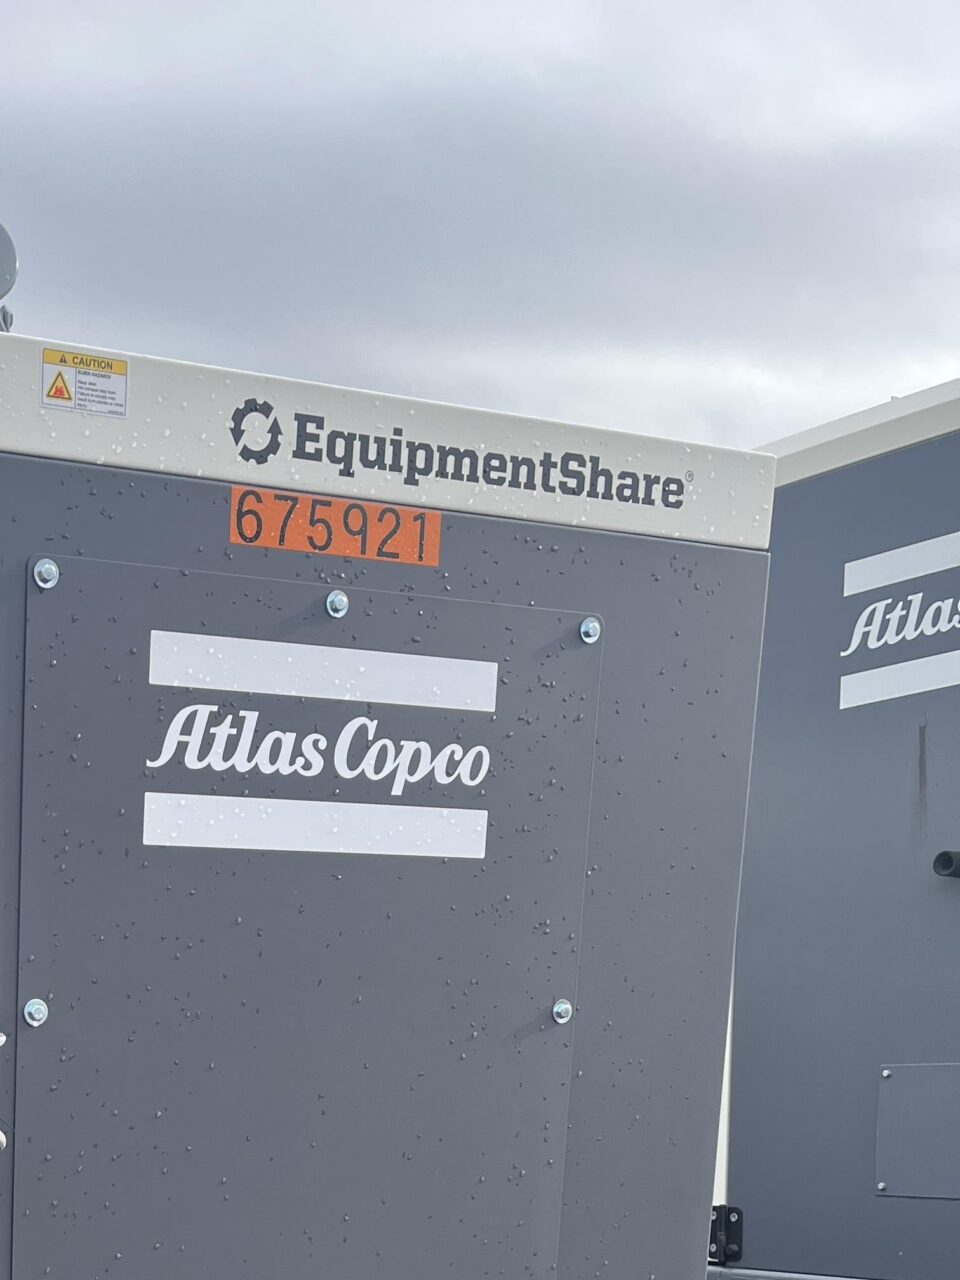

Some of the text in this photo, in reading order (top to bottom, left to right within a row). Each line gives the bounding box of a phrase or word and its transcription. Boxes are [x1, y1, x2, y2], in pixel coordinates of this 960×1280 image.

[72, 356, 113, 371] CAUTION
[292, 412, 685, 510] EquipmentShare
[236, 489, 427, 562] 675921
[146, 703, 491, 796] Atlas Copco
